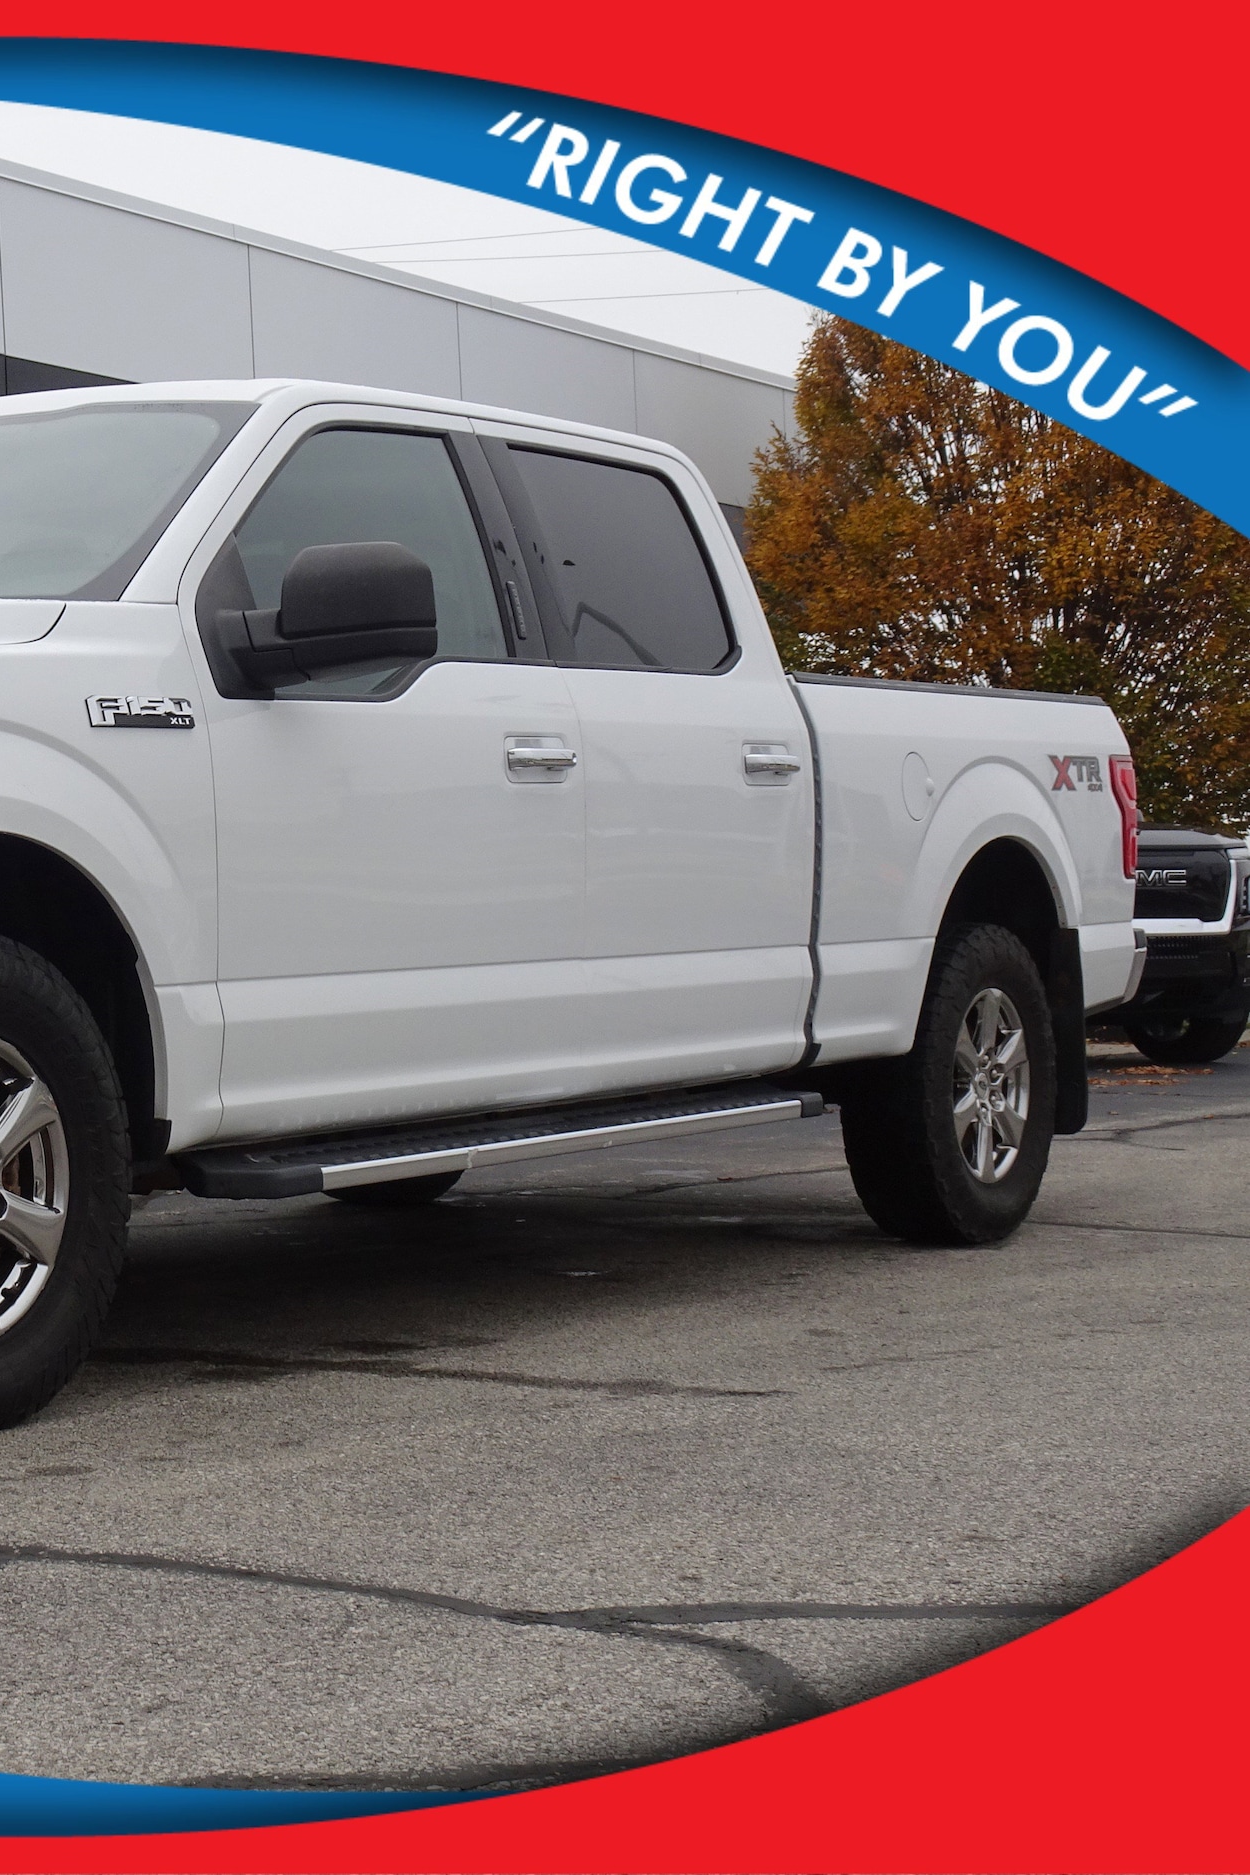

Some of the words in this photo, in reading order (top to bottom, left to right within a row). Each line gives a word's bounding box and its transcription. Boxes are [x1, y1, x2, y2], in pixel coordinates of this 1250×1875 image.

[170, 717, 191, 725] XLT
[1048, 755, 1103, 791] XTR
[1135, 870, 1187, 886] MC
